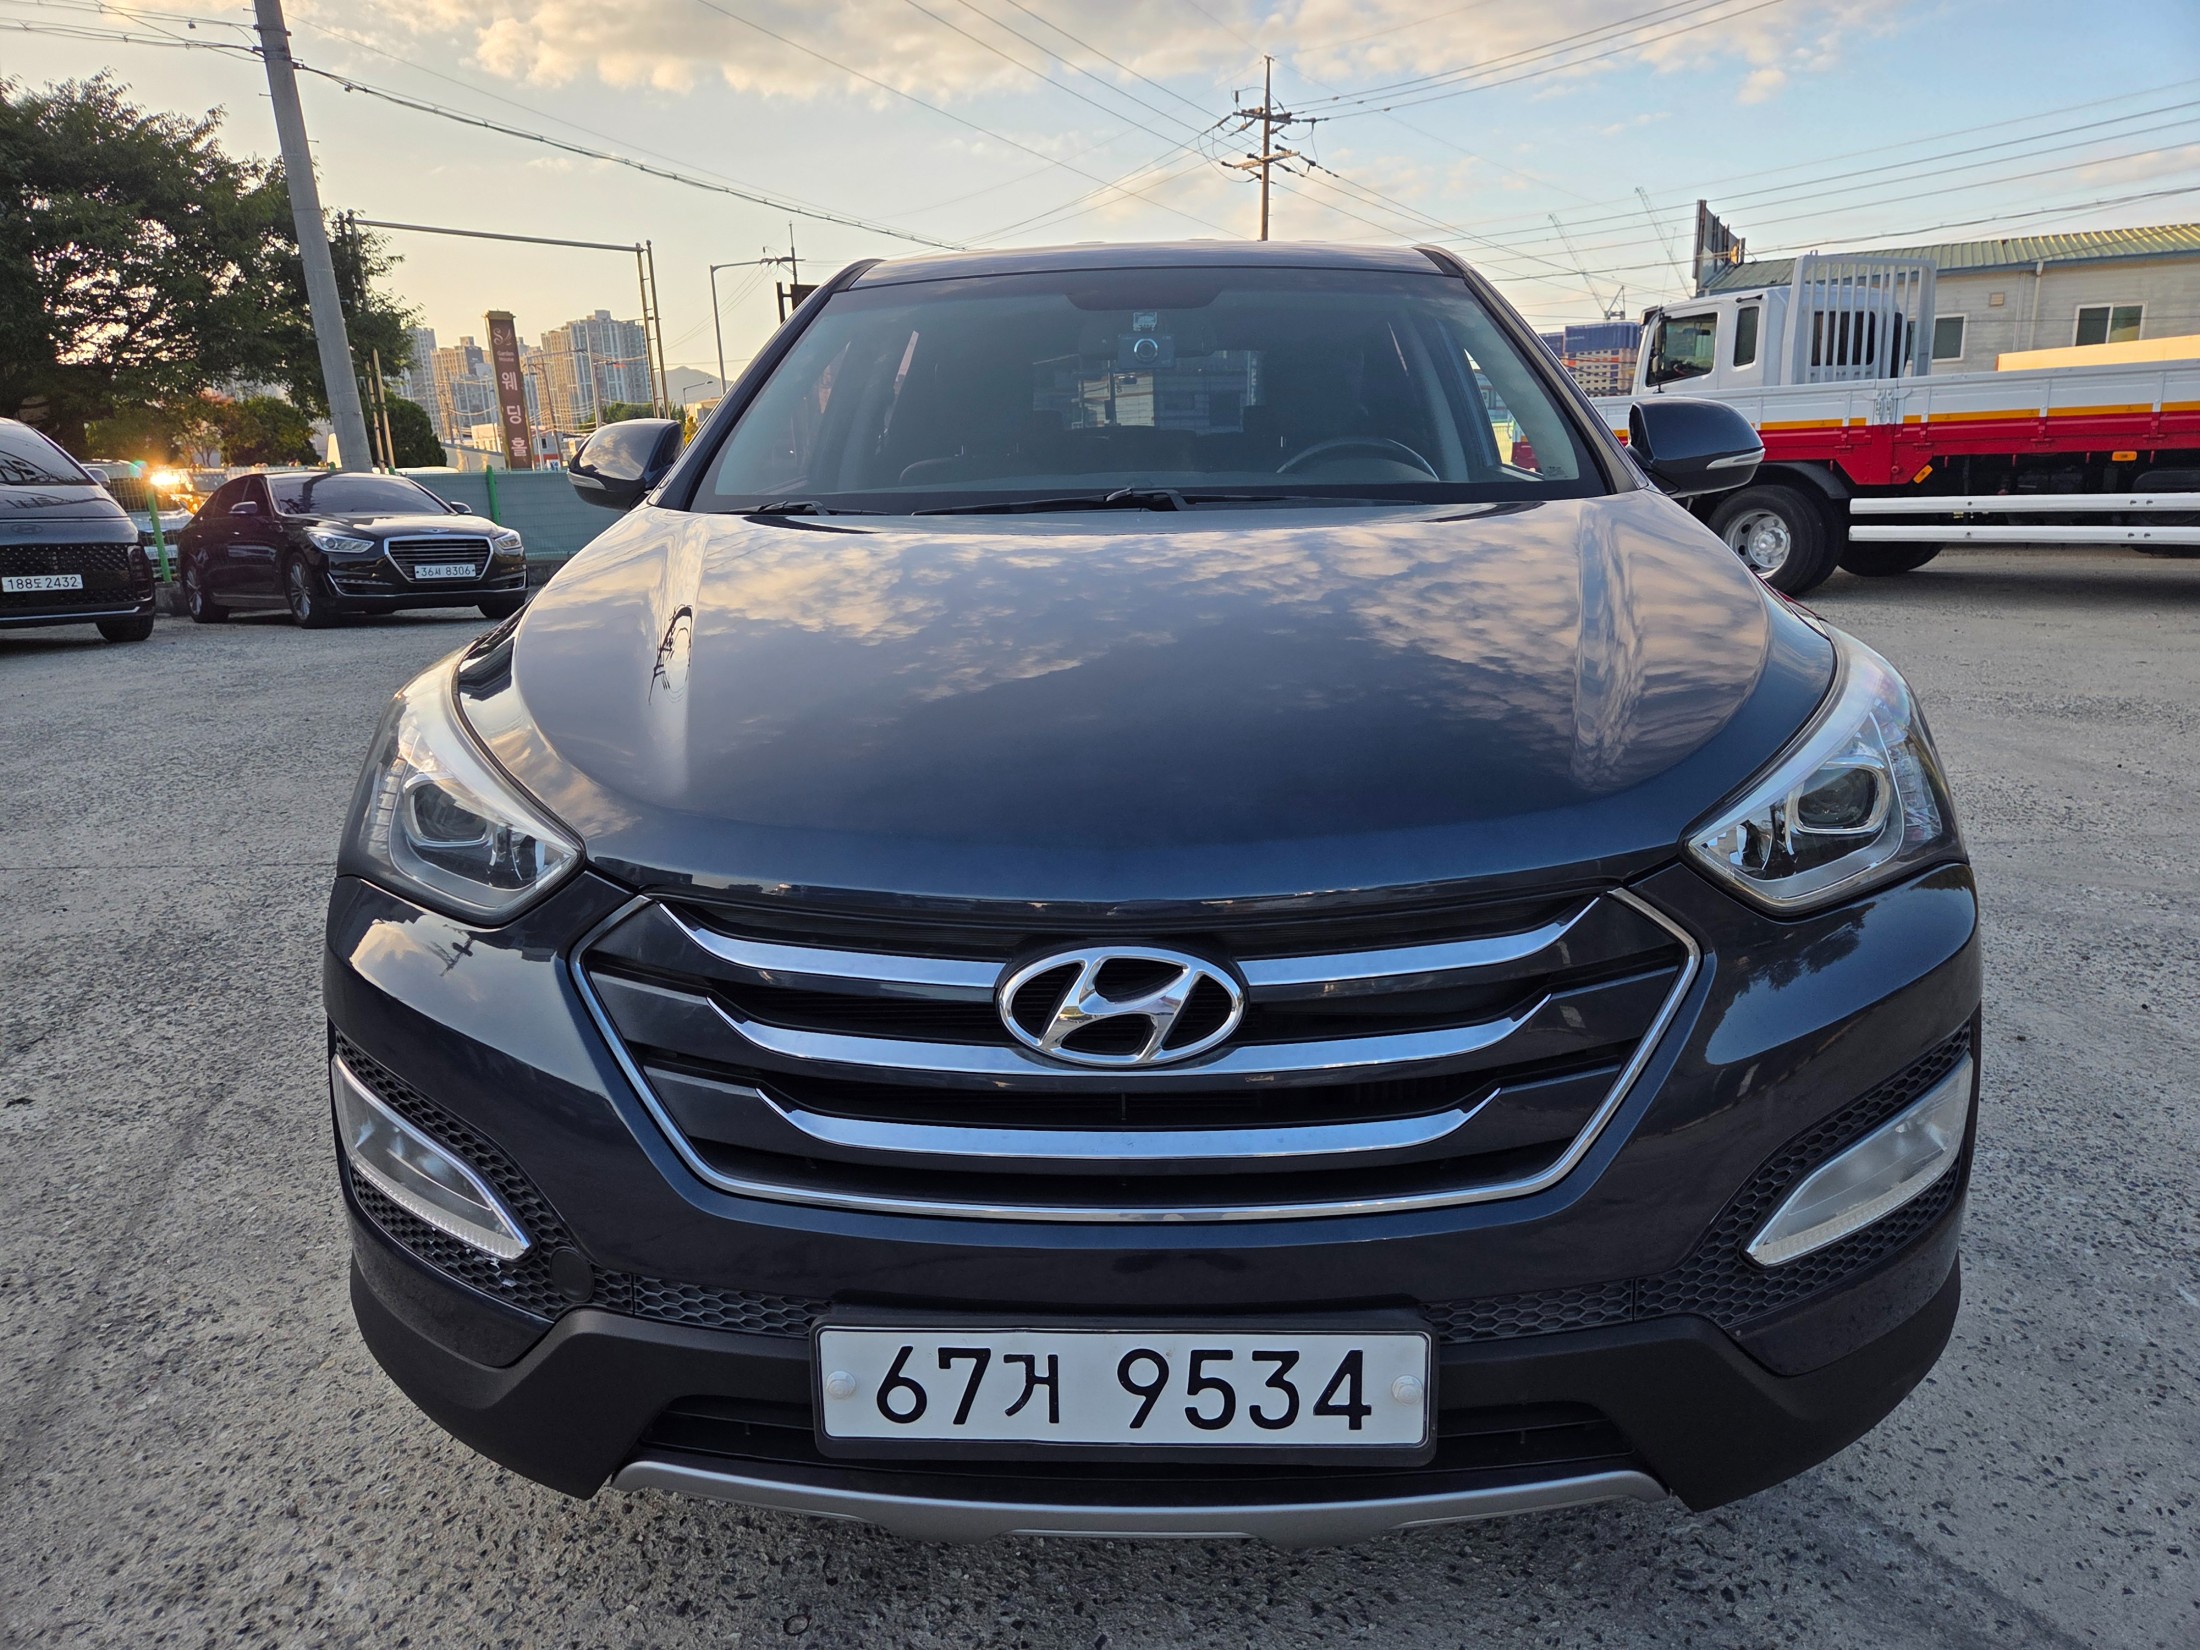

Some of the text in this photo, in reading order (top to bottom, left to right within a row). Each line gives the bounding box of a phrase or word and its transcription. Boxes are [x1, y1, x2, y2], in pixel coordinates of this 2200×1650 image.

[502, 371, 528, 457] 웨딩홀
[8, 576, 79, 590] 188도 2432
[445, 566, 471, 576] 8306
[876, 1345, 1372, 1430] 67거 9534
